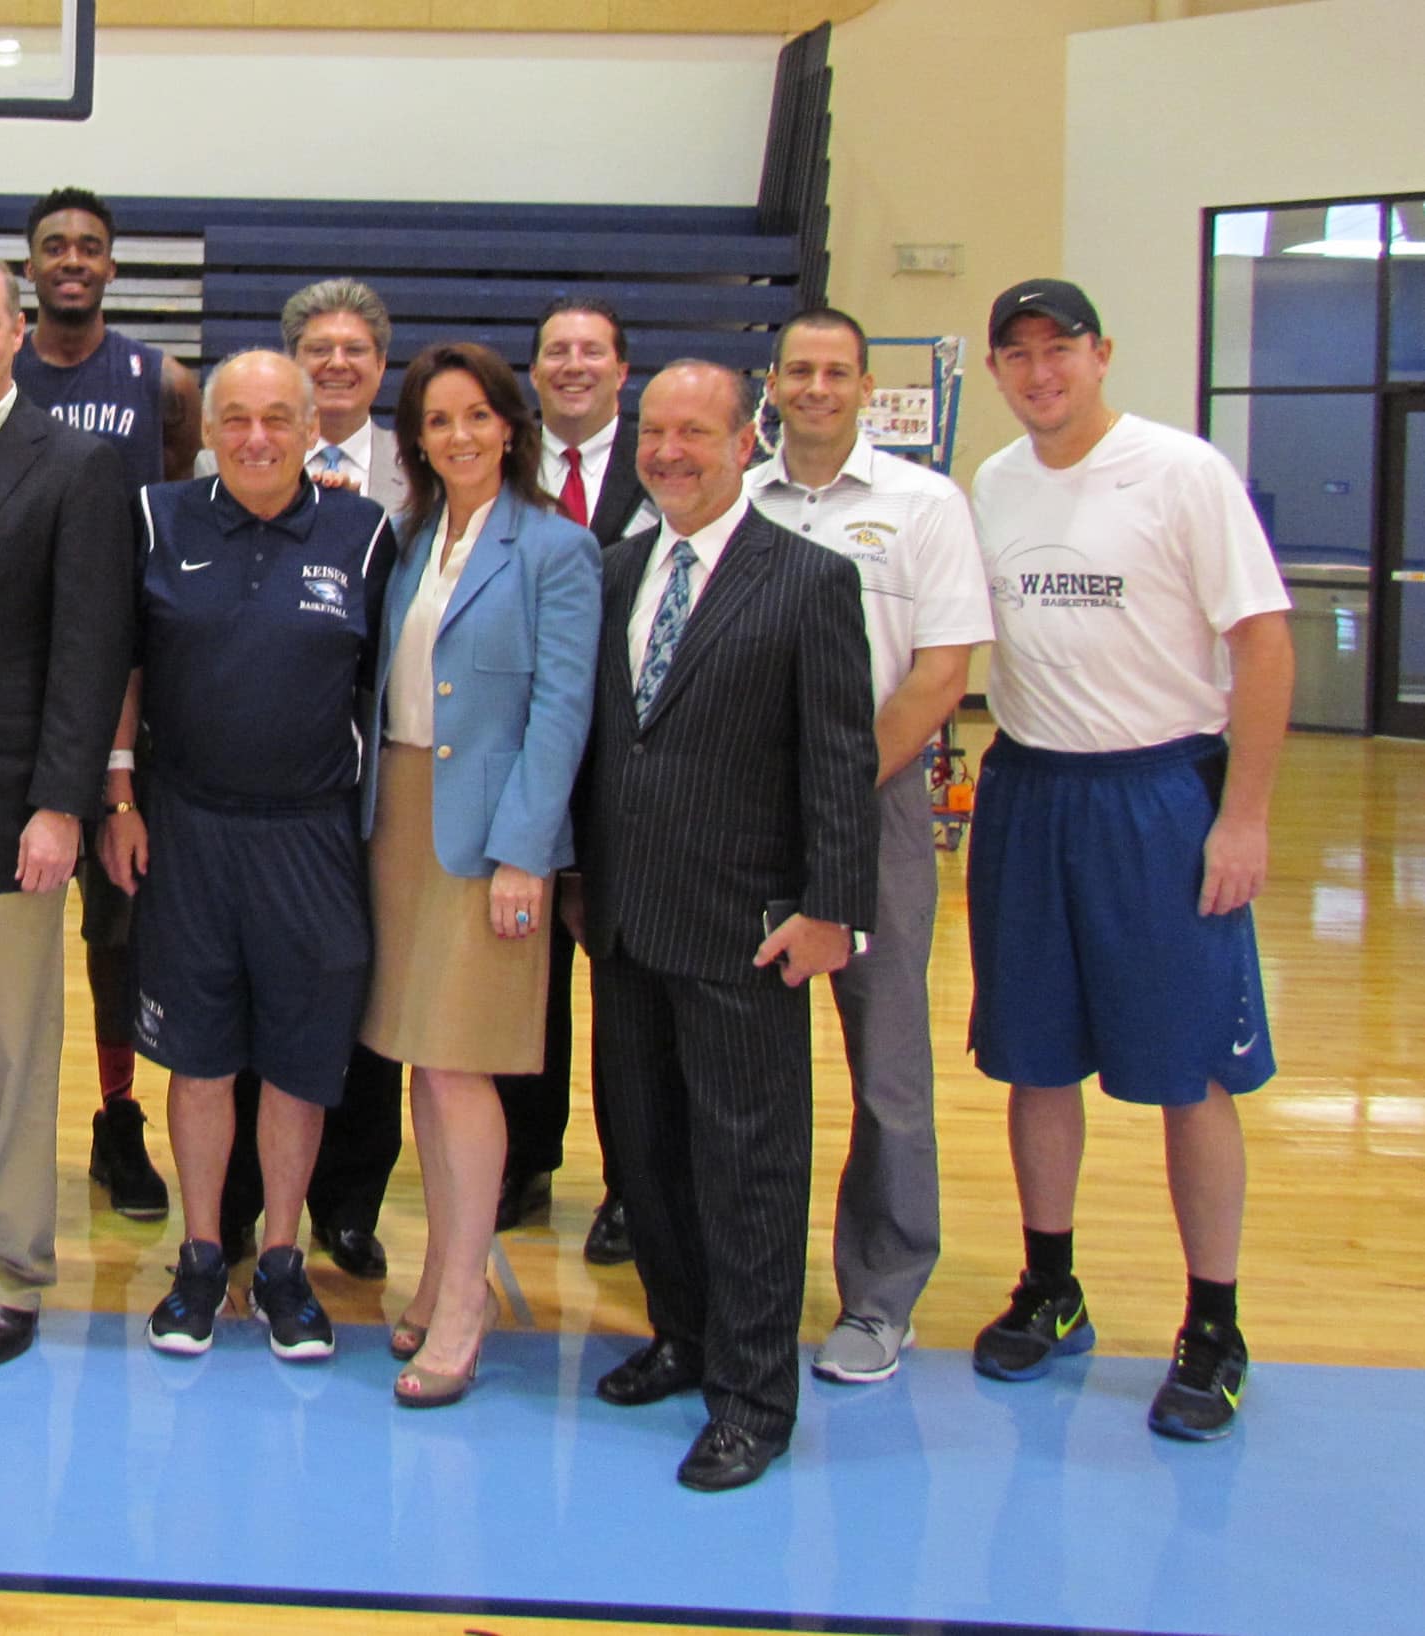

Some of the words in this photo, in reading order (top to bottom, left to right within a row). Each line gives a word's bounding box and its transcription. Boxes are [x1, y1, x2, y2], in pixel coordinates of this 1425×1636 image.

[302, 565, 348, 589] KEISER
[1020, 573, 1124, 598] WARNER
[299, 599, 348, 619] BASKETBALL
[1041, 597, 1126, 610] BASKETBALL
